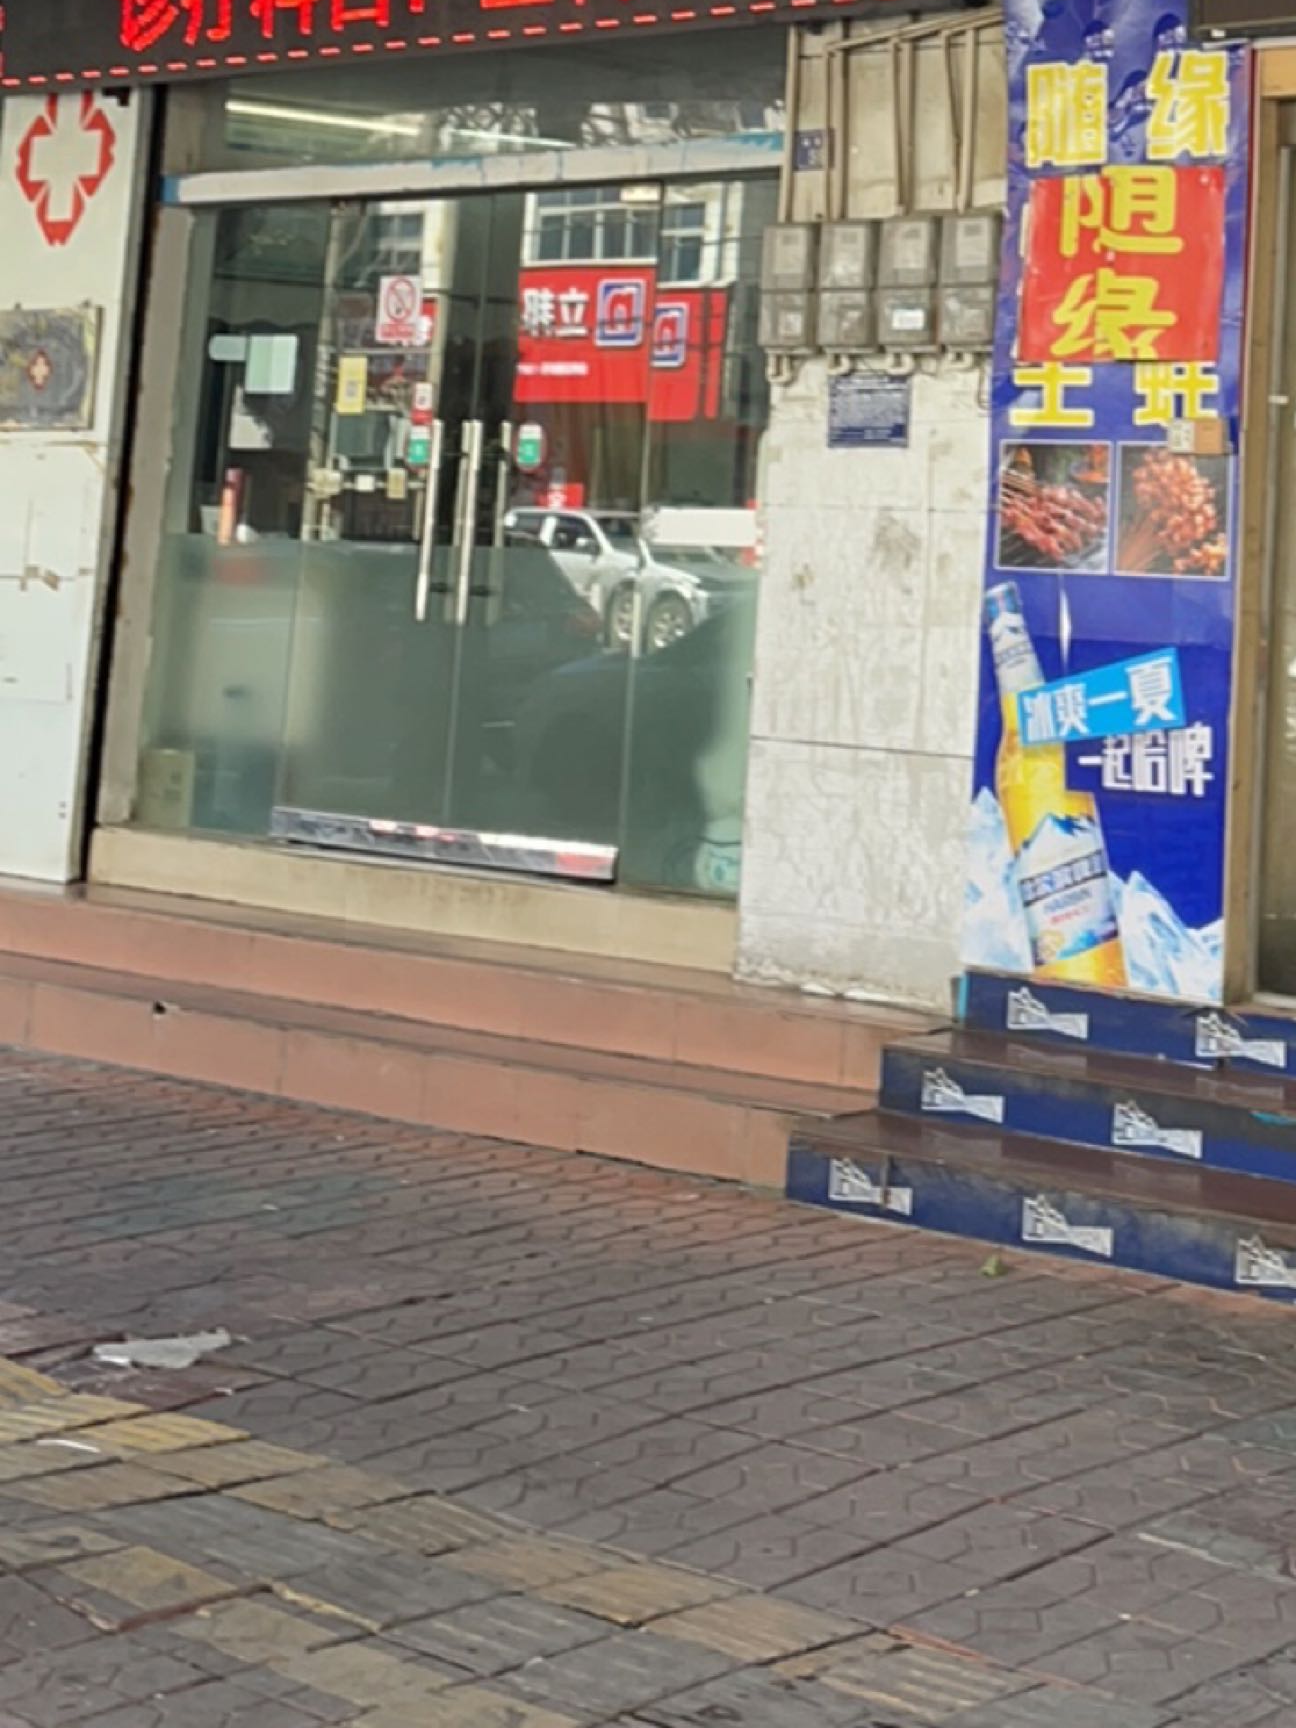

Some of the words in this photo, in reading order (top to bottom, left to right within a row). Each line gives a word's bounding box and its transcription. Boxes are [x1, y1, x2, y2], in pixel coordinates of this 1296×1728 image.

[1026, 50, 1229, 167] 随缘
[1022, 656, 1176, 742] 冰爽一夏
